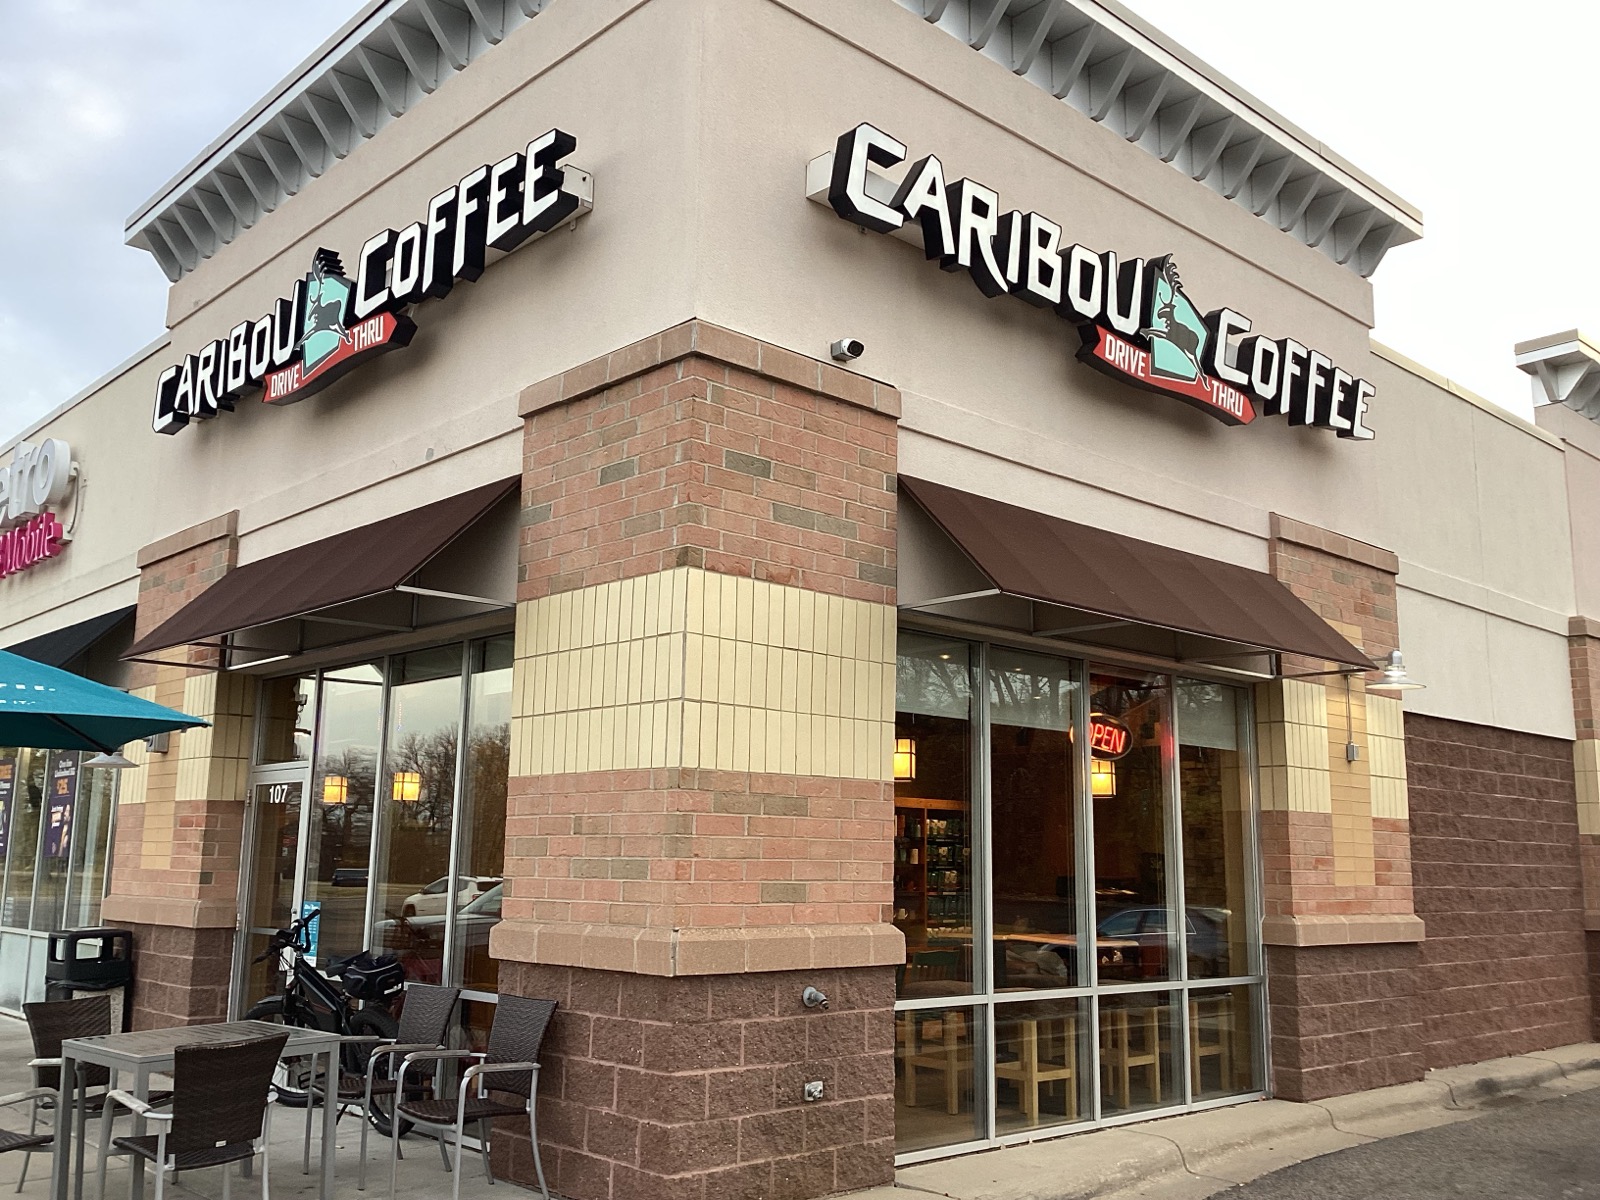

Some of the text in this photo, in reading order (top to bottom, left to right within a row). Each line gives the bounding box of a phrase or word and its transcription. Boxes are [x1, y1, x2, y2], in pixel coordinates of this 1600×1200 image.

[152, 127, 562, 433] CARIBOU COFFEE
[843, 122, 1376, 440] CARIBOU COFFEE
[269, 315, 385, 398] DRIVE THRU
[1104, 333, 1244, 418] DRIVE THRU
[269, 784, 288, 804] 107
